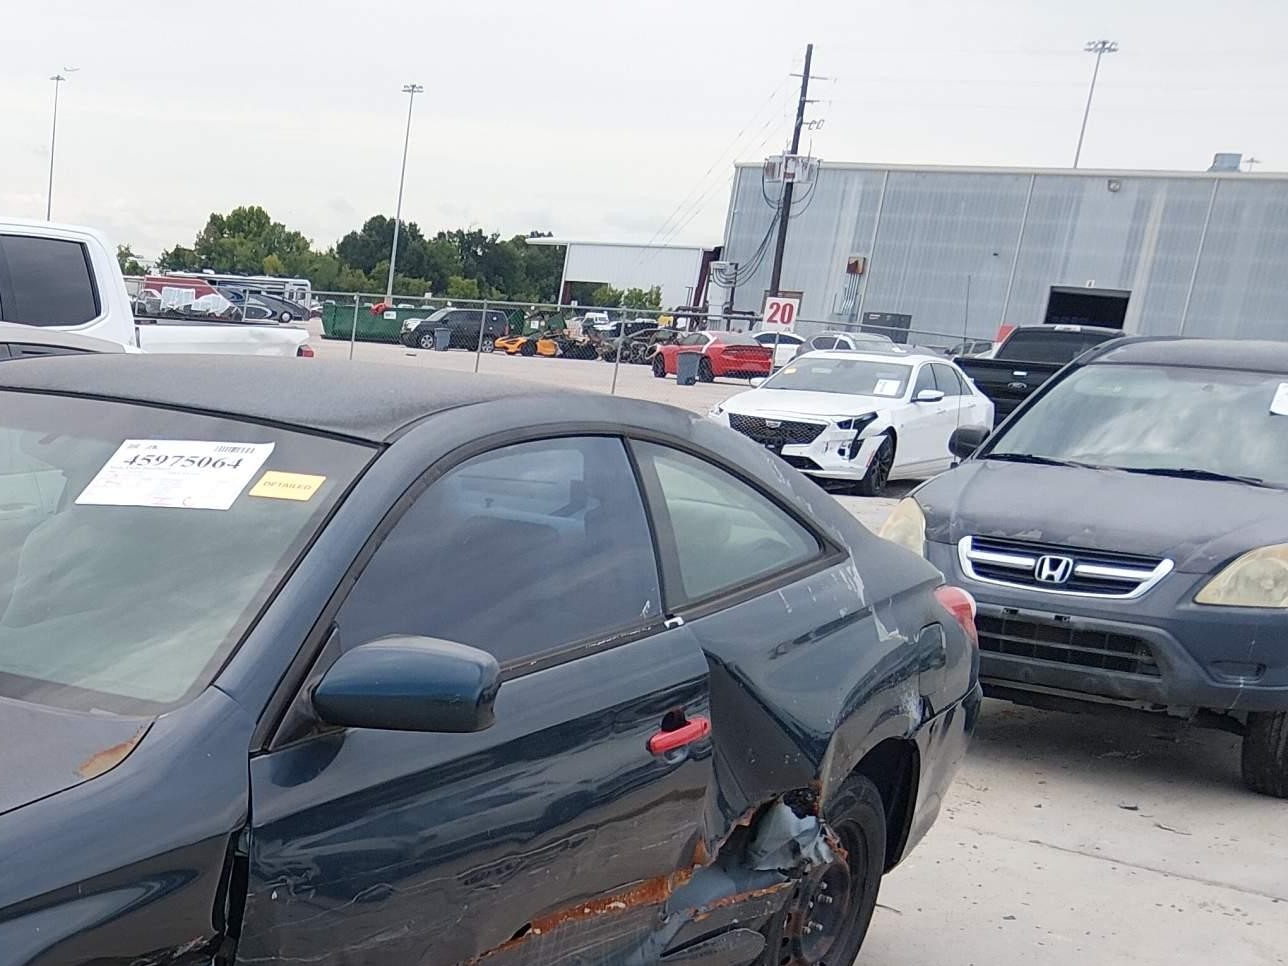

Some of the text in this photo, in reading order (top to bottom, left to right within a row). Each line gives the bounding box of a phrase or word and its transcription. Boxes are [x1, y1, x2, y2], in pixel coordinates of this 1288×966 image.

[767, 302, 794, 324] 20
[123, 453, 245, 470] 45975064
[262, 480, 313, 491] DETAILED
